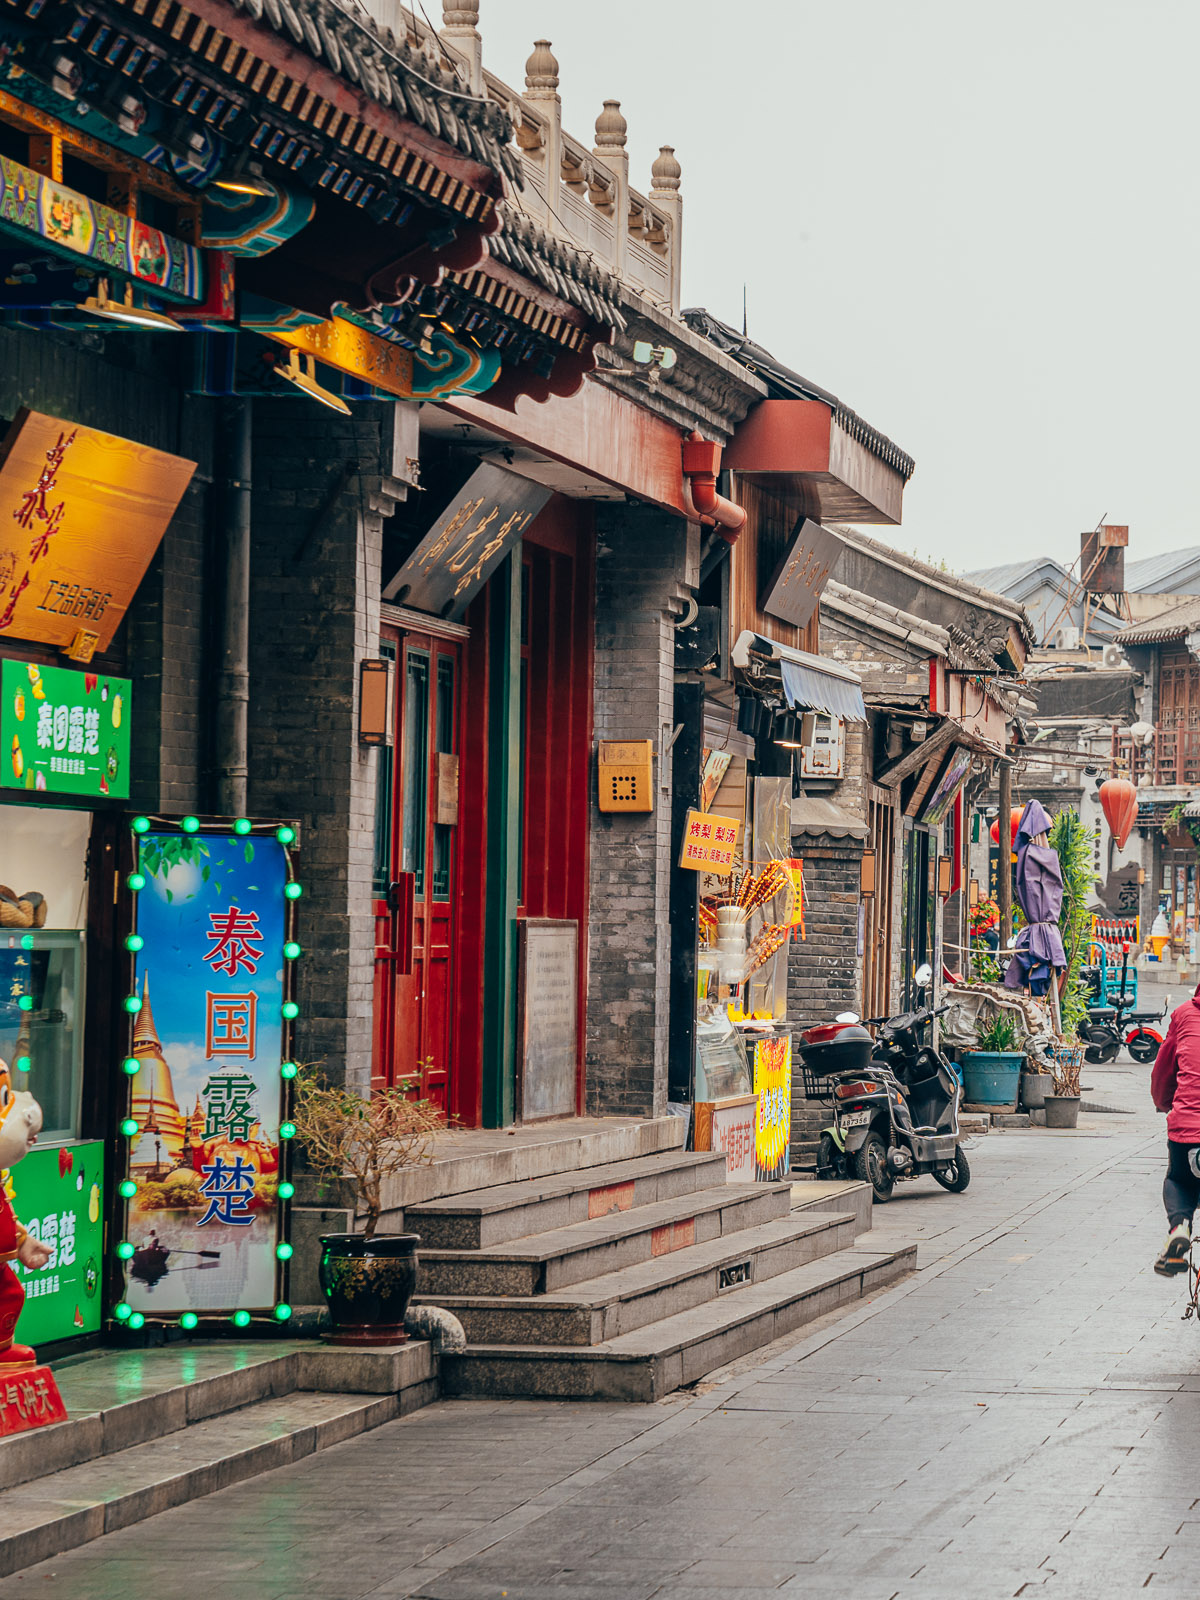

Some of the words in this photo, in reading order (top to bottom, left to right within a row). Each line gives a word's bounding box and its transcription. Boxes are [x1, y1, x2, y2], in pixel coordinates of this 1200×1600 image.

[690, 821, 711, 839] 烤梨
[715, 826, 736, 843] 梨汤
[197, 905, 265, 1227] 泰国露楚
